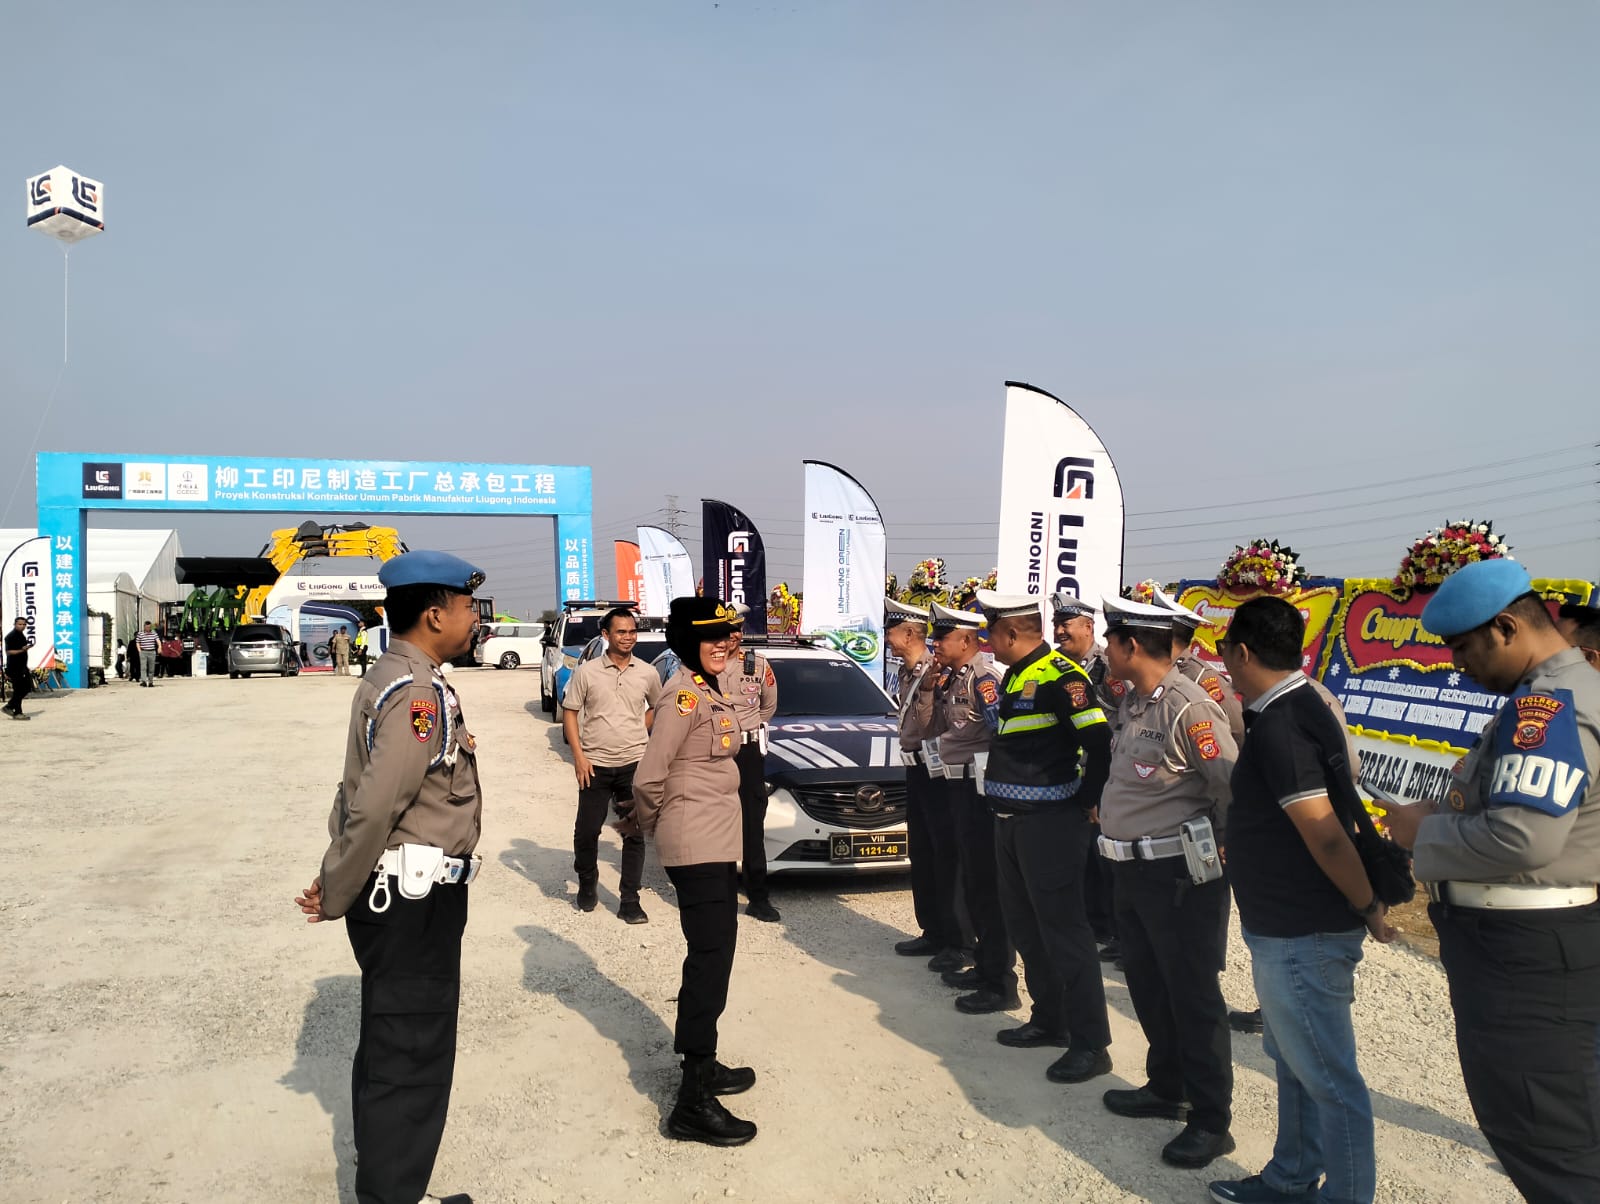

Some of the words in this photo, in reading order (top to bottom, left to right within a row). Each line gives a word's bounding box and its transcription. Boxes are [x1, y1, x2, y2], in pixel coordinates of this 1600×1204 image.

[215, 465, 556, 494] 柳工印尼制造工厂总承包工程
[215, 490, 250, 501] Proyek
[251, 490, 305, 501] Konstruksi
[307, 491, 358, 502] Kontraktor
[360, 493, 390, 502] Umum
[392, 493, 421, 503] Pabrik
[423, 494, 474, 504] Manufaktur
[476, 495, 512, 505] Liugong
[514, 495, 556, 505] Indonesia
[565, 538, 581, 601] 以品质塑
[1028, 511, 1043, 595] INDONES
[1056, 513, 1085, 601] LIUG
[731, 558, 746, 606] LIUG
[1139, 729, 1165, 742] POLRI
[1403, 761, 1453, 805] ENGIN
[1490, 753, 1585, 808] ROV
[860, 845, 898, 856] 1121-48
